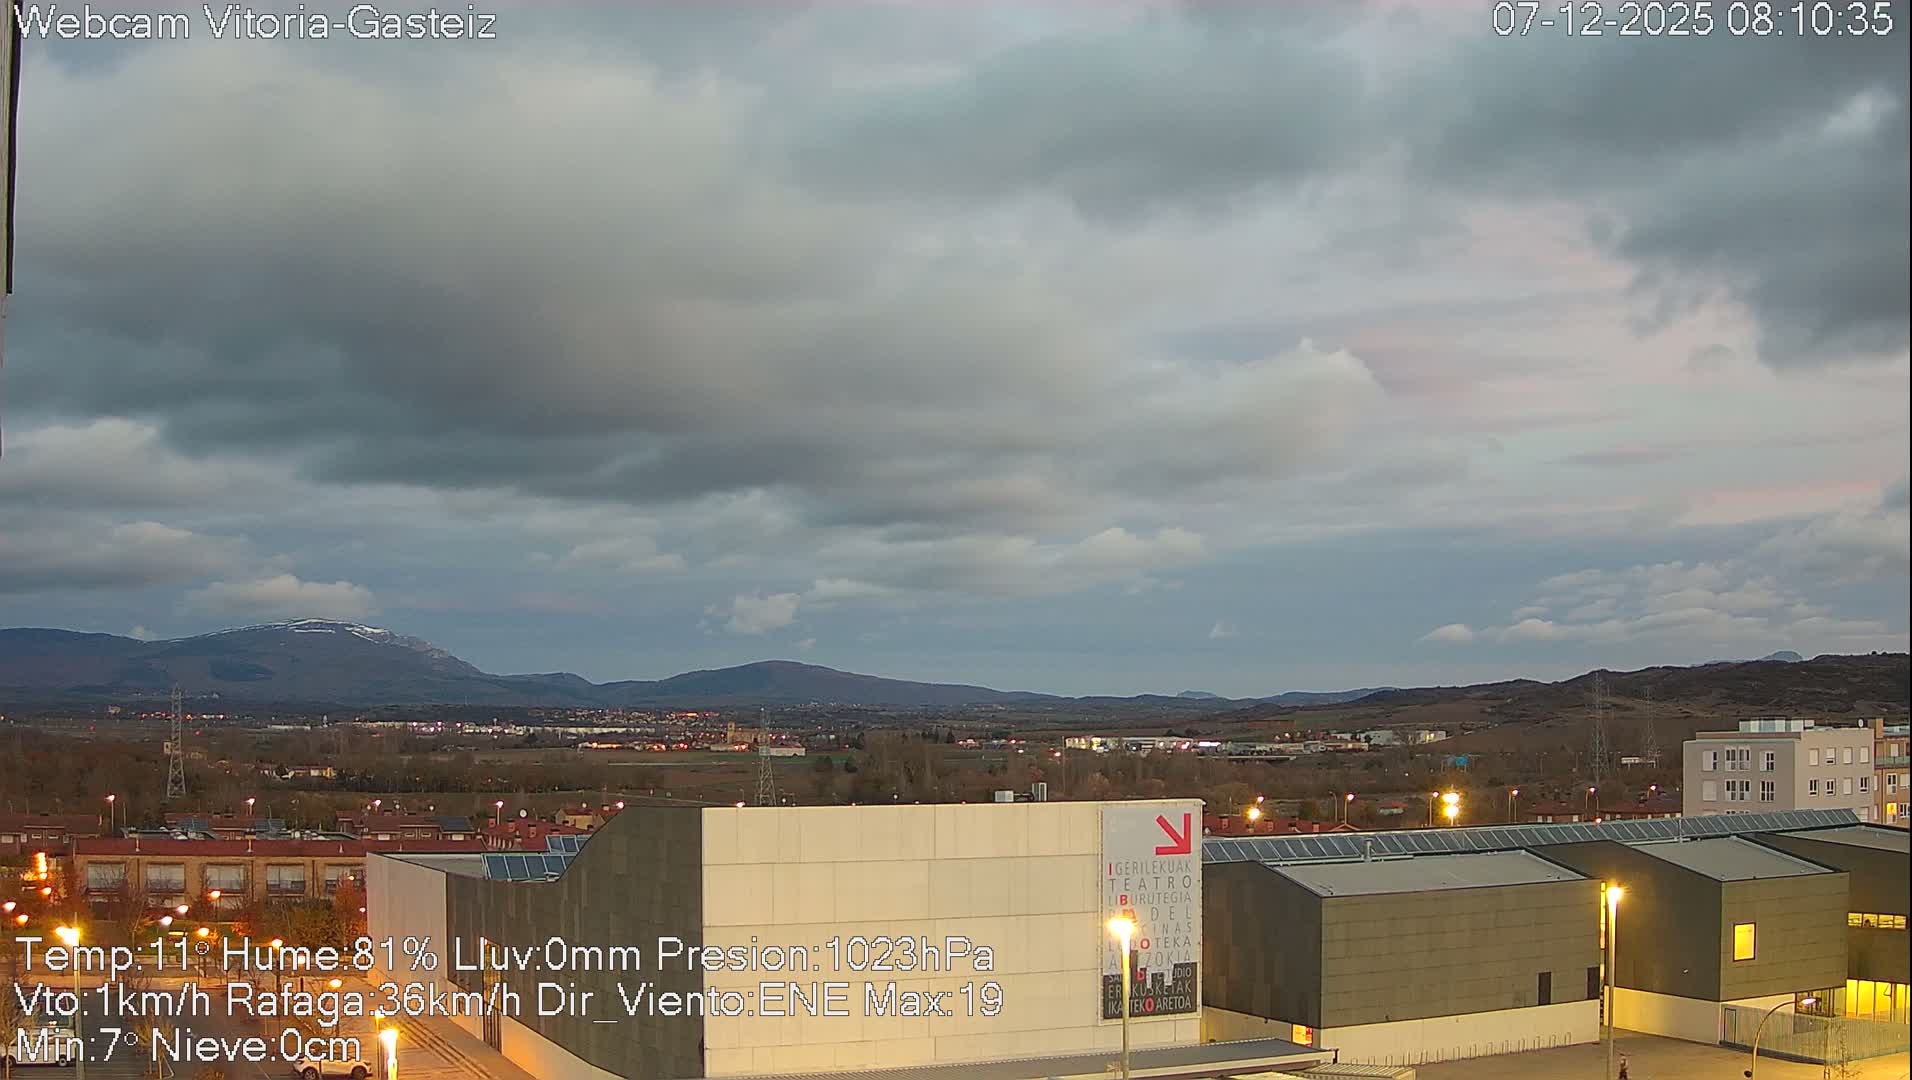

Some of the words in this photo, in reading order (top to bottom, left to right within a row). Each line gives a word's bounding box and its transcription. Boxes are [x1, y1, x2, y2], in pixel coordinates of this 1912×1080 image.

[1108, 860, 1192, 876] IGERILEKUAK
[1108, 875, 1192, 893] TEATRO
[1108, 890, 1192, 907] LIBURUTEGIA
[1108, 980, 1192, 999] ERKUSKETAK
[1108, 997, 1154, 1015] IKATEKO
[1155, 995, 1192, 1010] ARETOA
